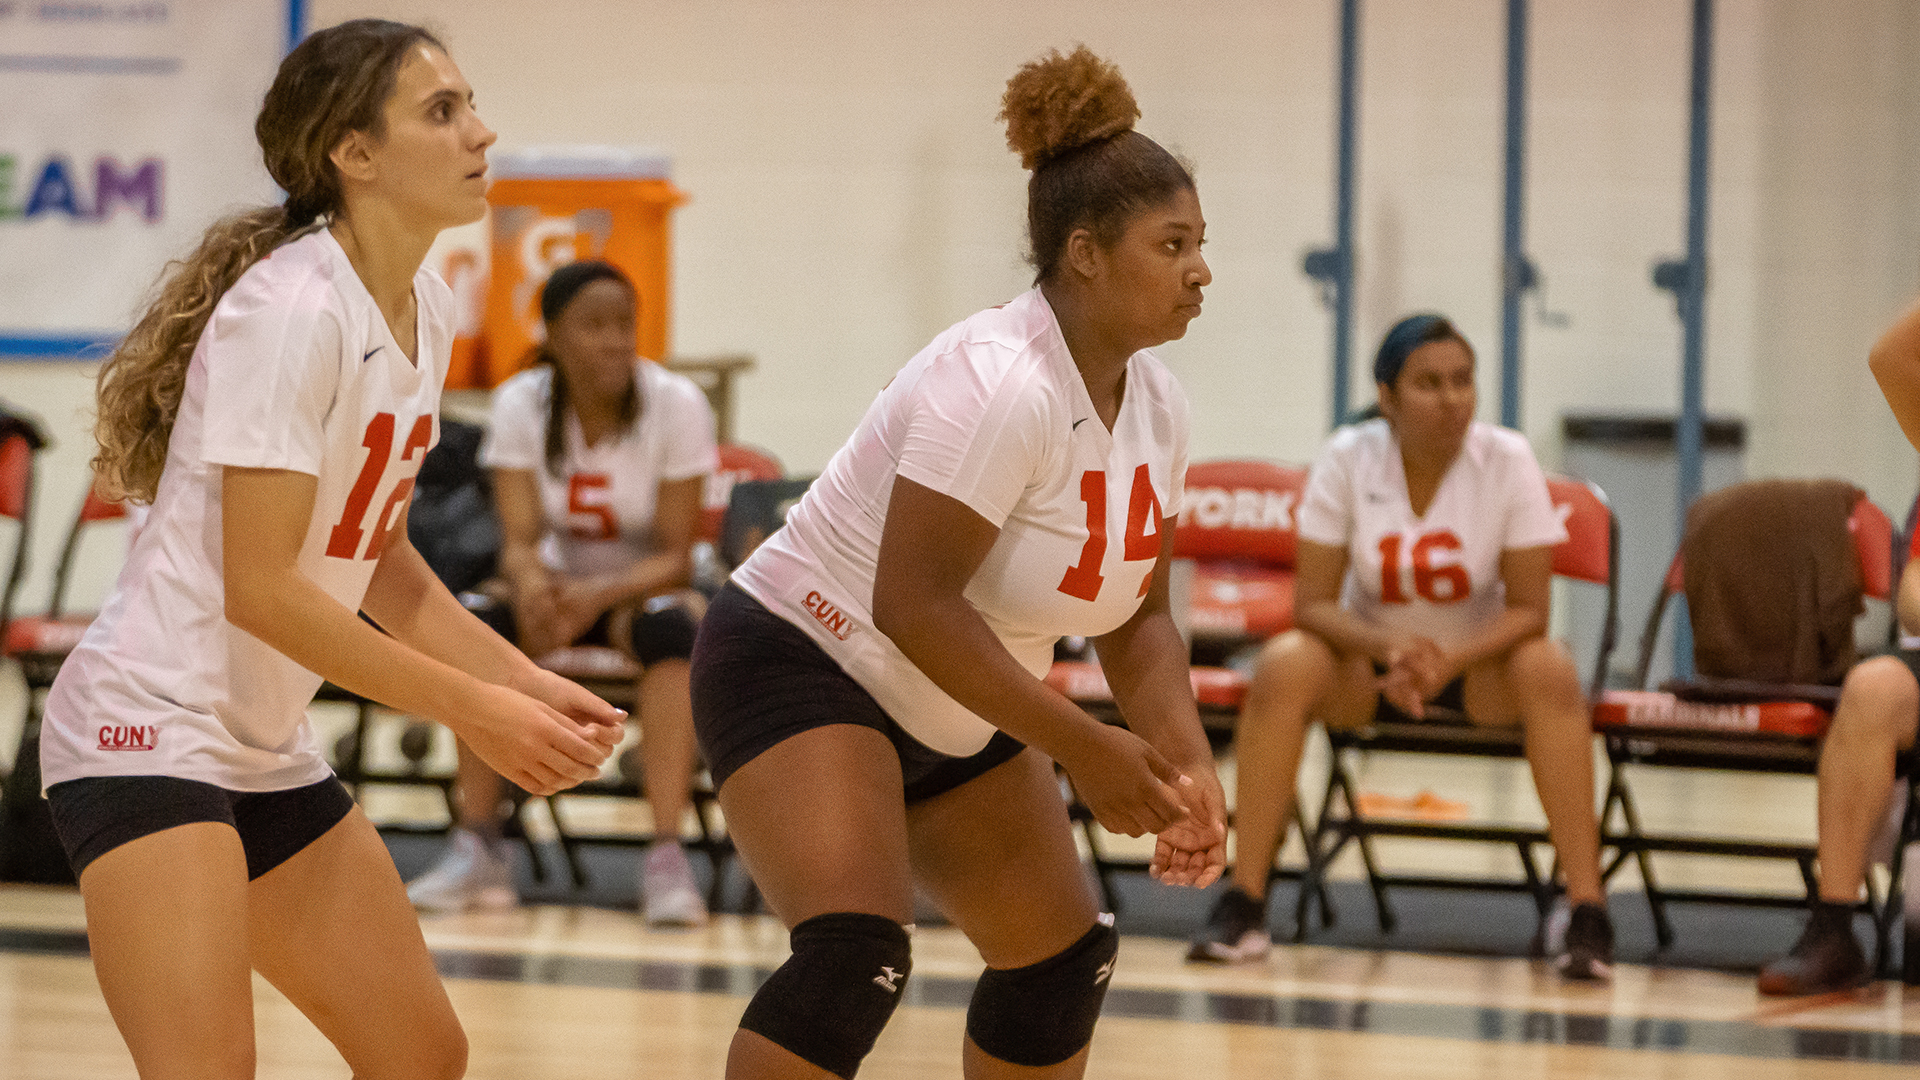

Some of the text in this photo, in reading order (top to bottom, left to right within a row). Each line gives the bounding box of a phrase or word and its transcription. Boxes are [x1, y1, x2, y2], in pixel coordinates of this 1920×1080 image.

[326, 412, 431, 560] 12
[568, 474, 618, 541] 5
[1178, 488, 1292, 530] YORK
[1057, 463, 1163, 602] 14
[1378, 528, 1471, 605] 16
[98, 725, 162, 748] CUNY
